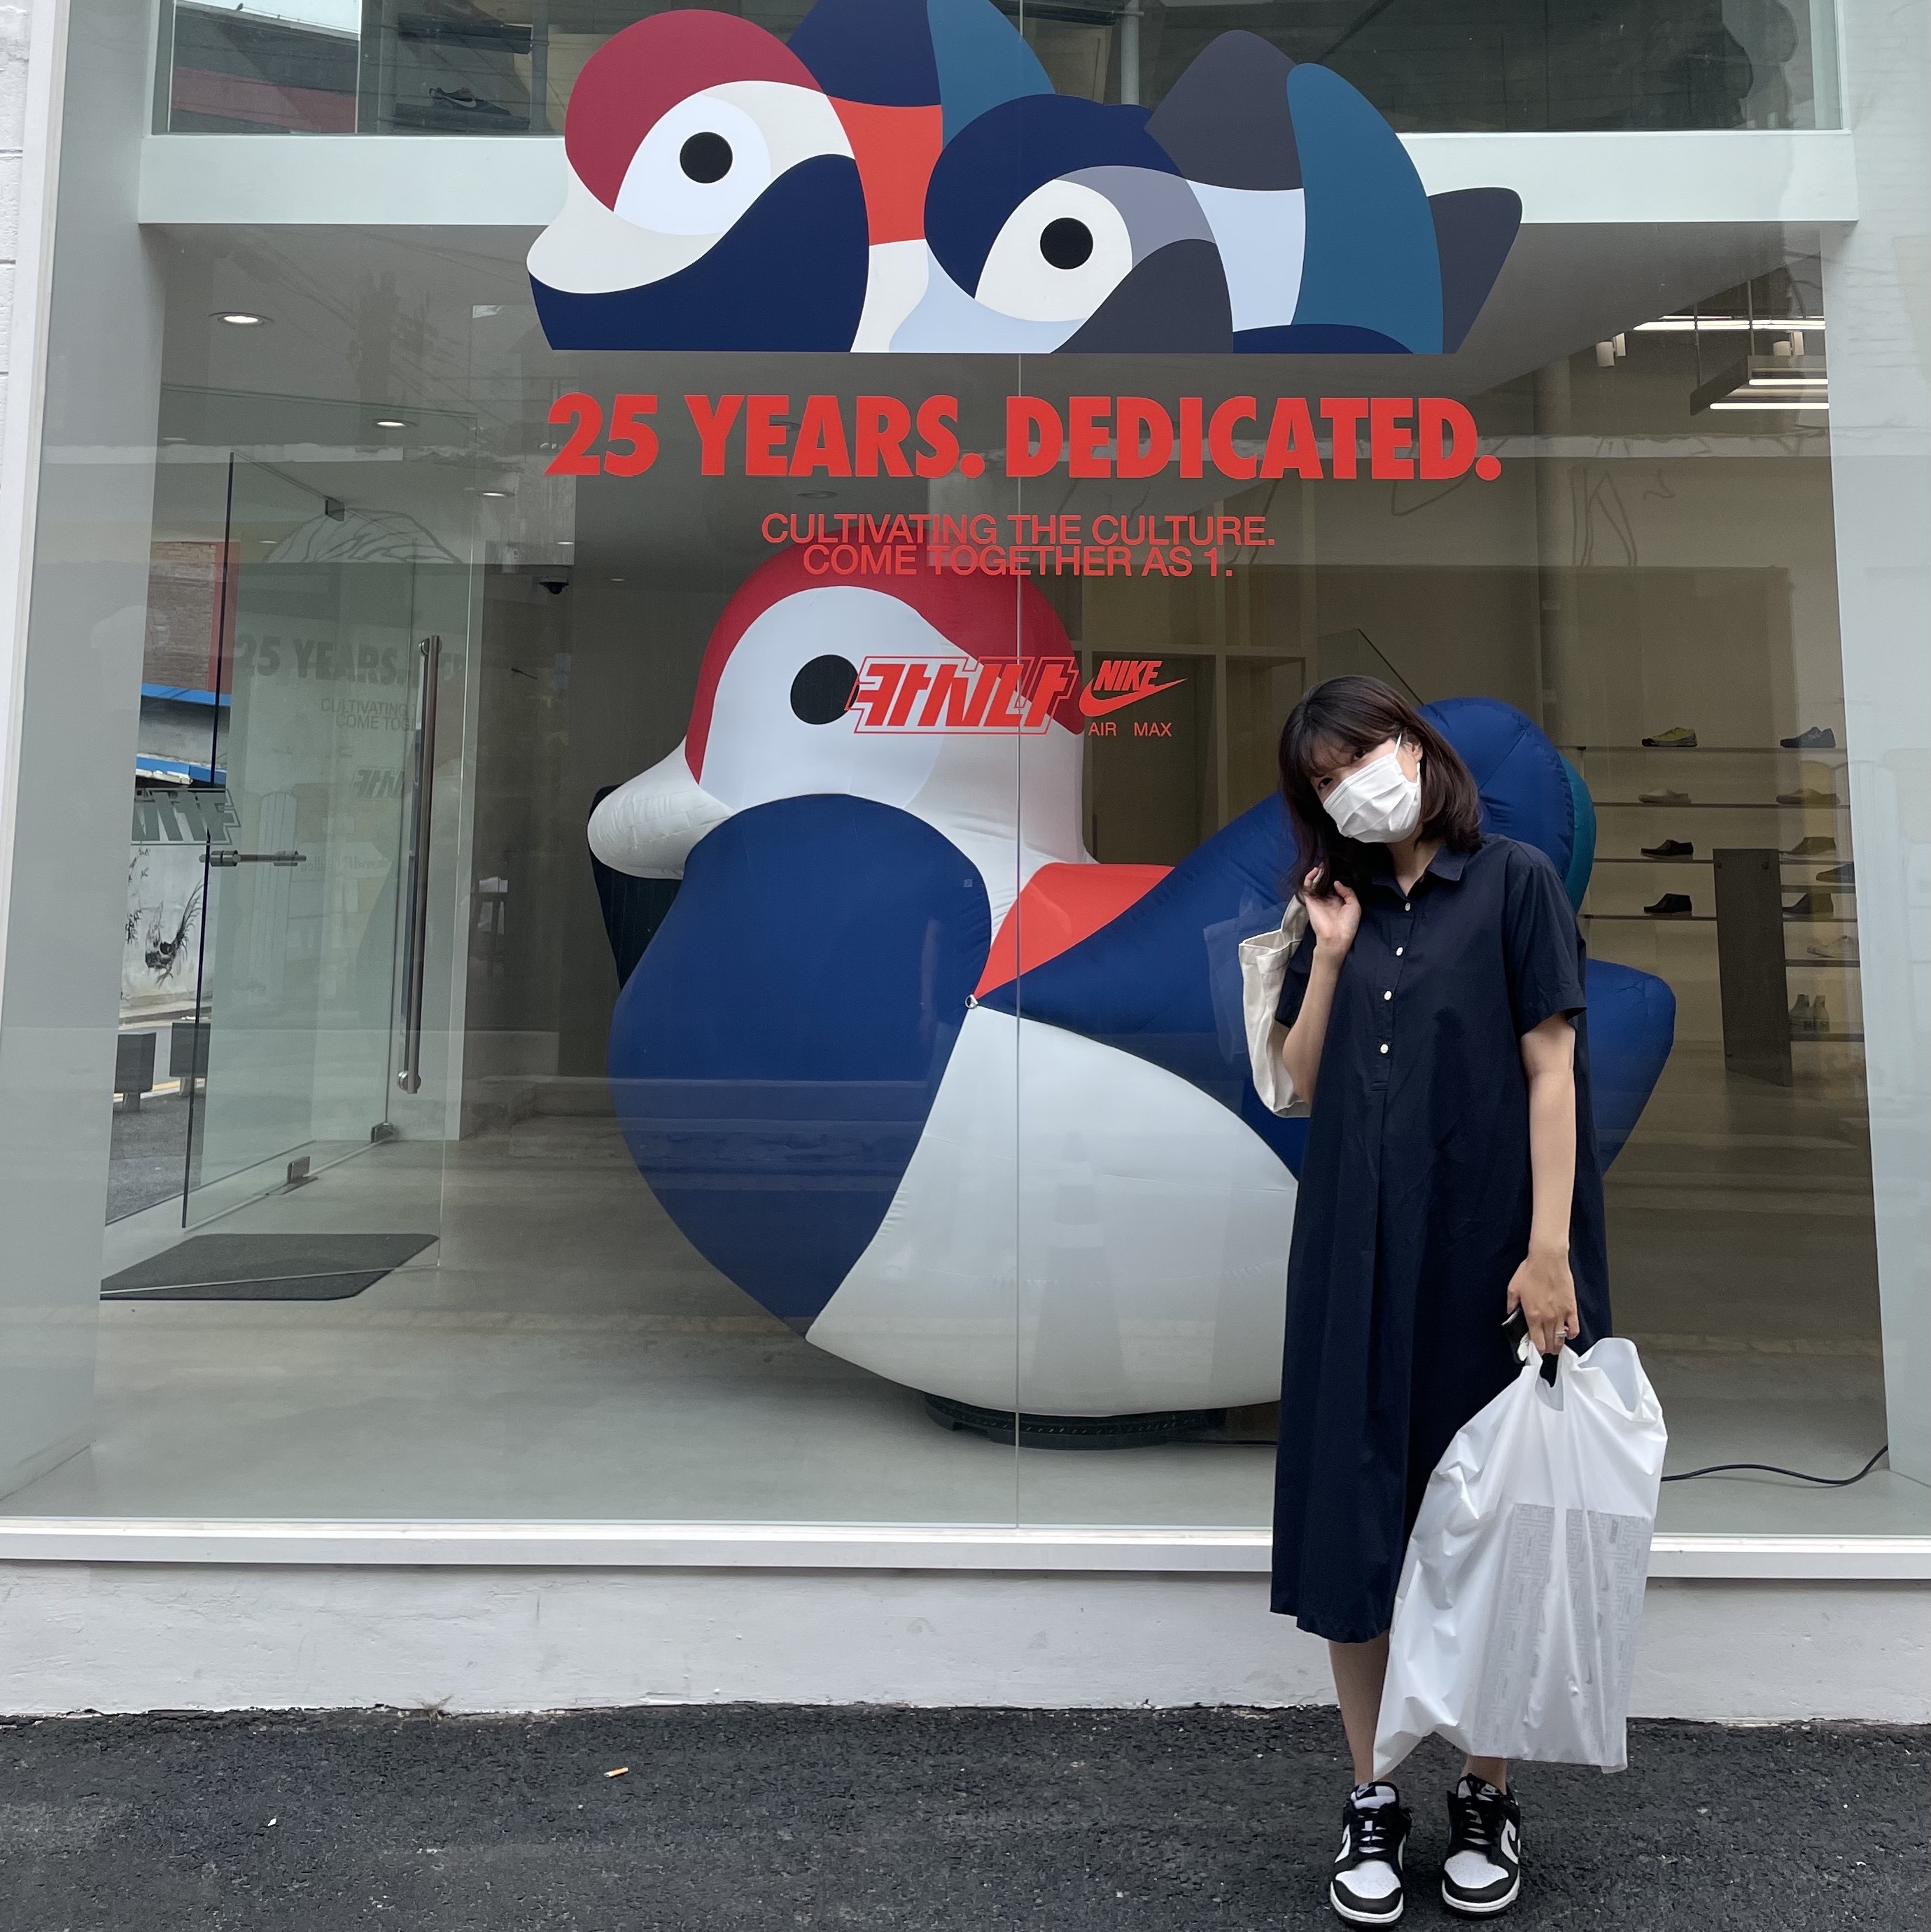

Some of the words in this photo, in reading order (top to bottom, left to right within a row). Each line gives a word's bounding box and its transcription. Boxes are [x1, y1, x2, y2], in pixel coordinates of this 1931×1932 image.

[544, 393, 659, 477] 25
[684, 395, 985, 478] YEARS.
[1006, 396, 1502, 481] DEDICATED.
[761, 513, 997, 544] CULTIVATING
[1007, 514, 1081, 545] THE
[1092, 515, 1275, 546] CULTURE.
[803, 545, 917, 575] COME
[926, 546, 1132, 576] TOGETHER
[1142, 546, 1193, 576] AS
[1204, 547, 1233, 576] 1.
[1093, 660, 1163, 692] NIKE
[1088, 722, 1117, 737] AIR
[1134, 722, 1172, 737] MAX
